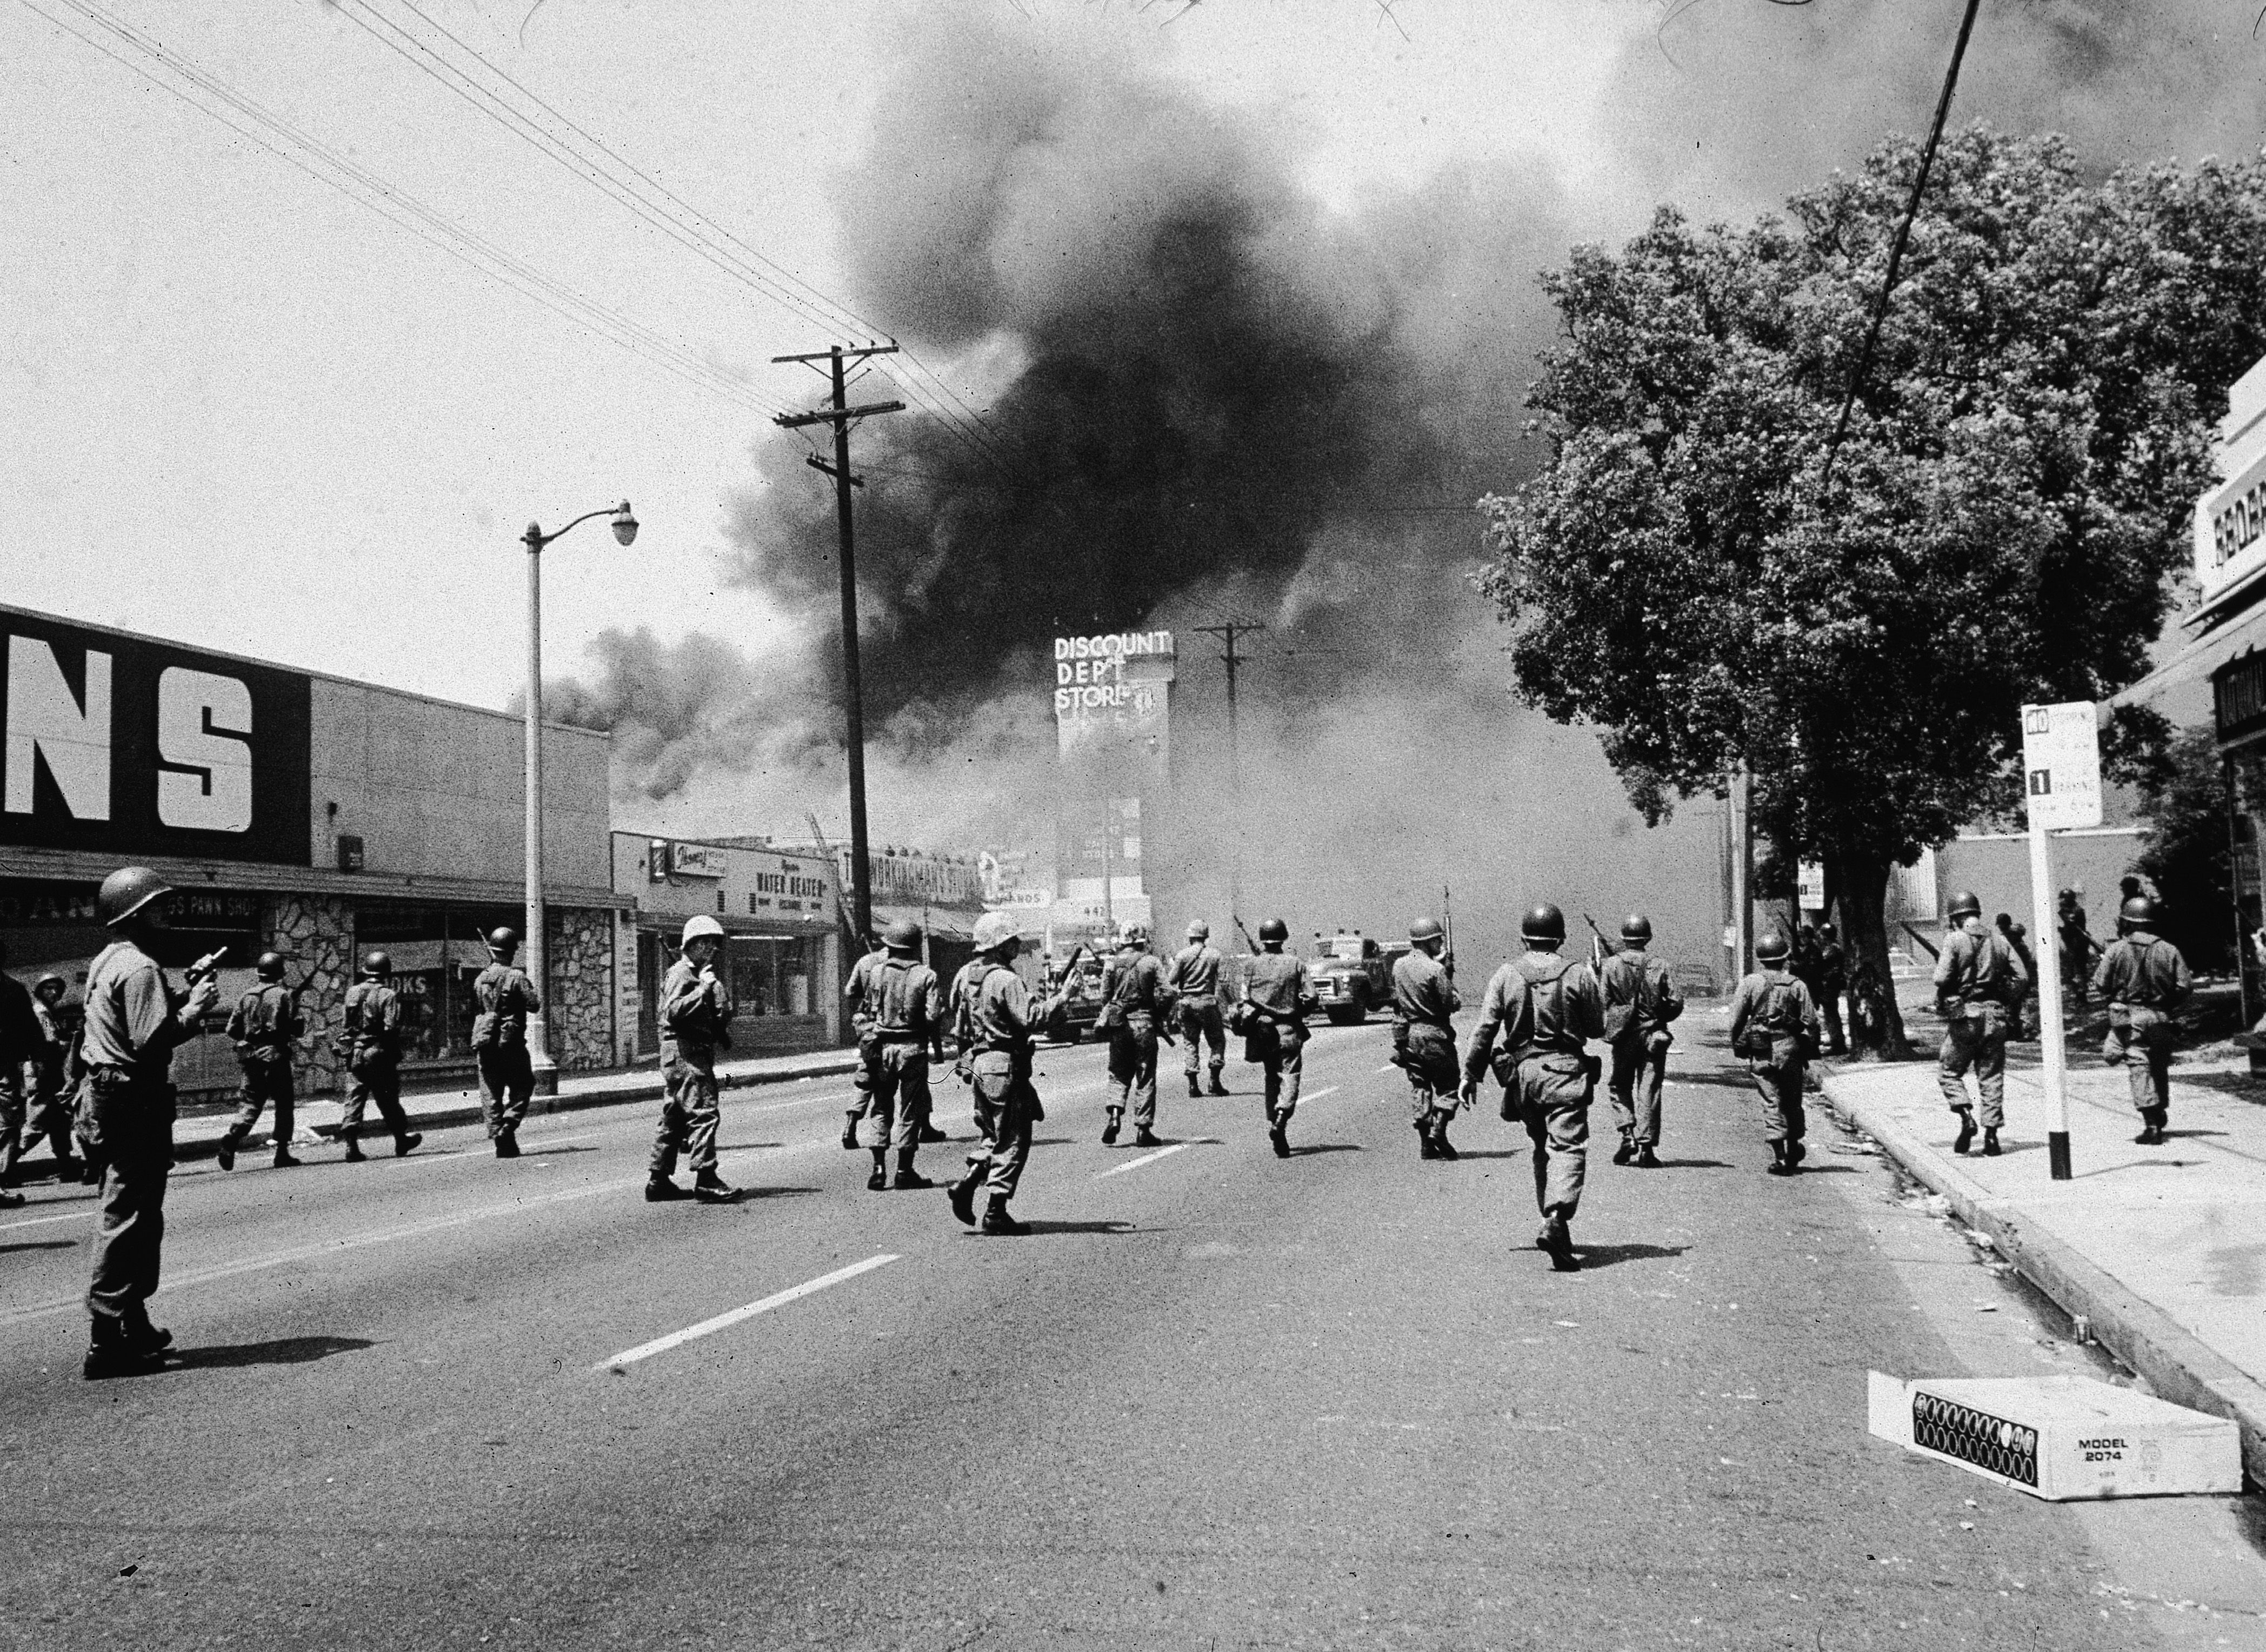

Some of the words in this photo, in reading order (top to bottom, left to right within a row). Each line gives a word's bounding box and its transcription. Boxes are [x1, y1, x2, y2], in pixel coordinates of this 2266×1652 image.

[1055, 631, 1170, 660] DISCOUNT
[191, 895, 221, 915] PAWN
[2078, 1439, 2129, 1449] MODEL
[2085, 1451, 2122, 1462] 2074
